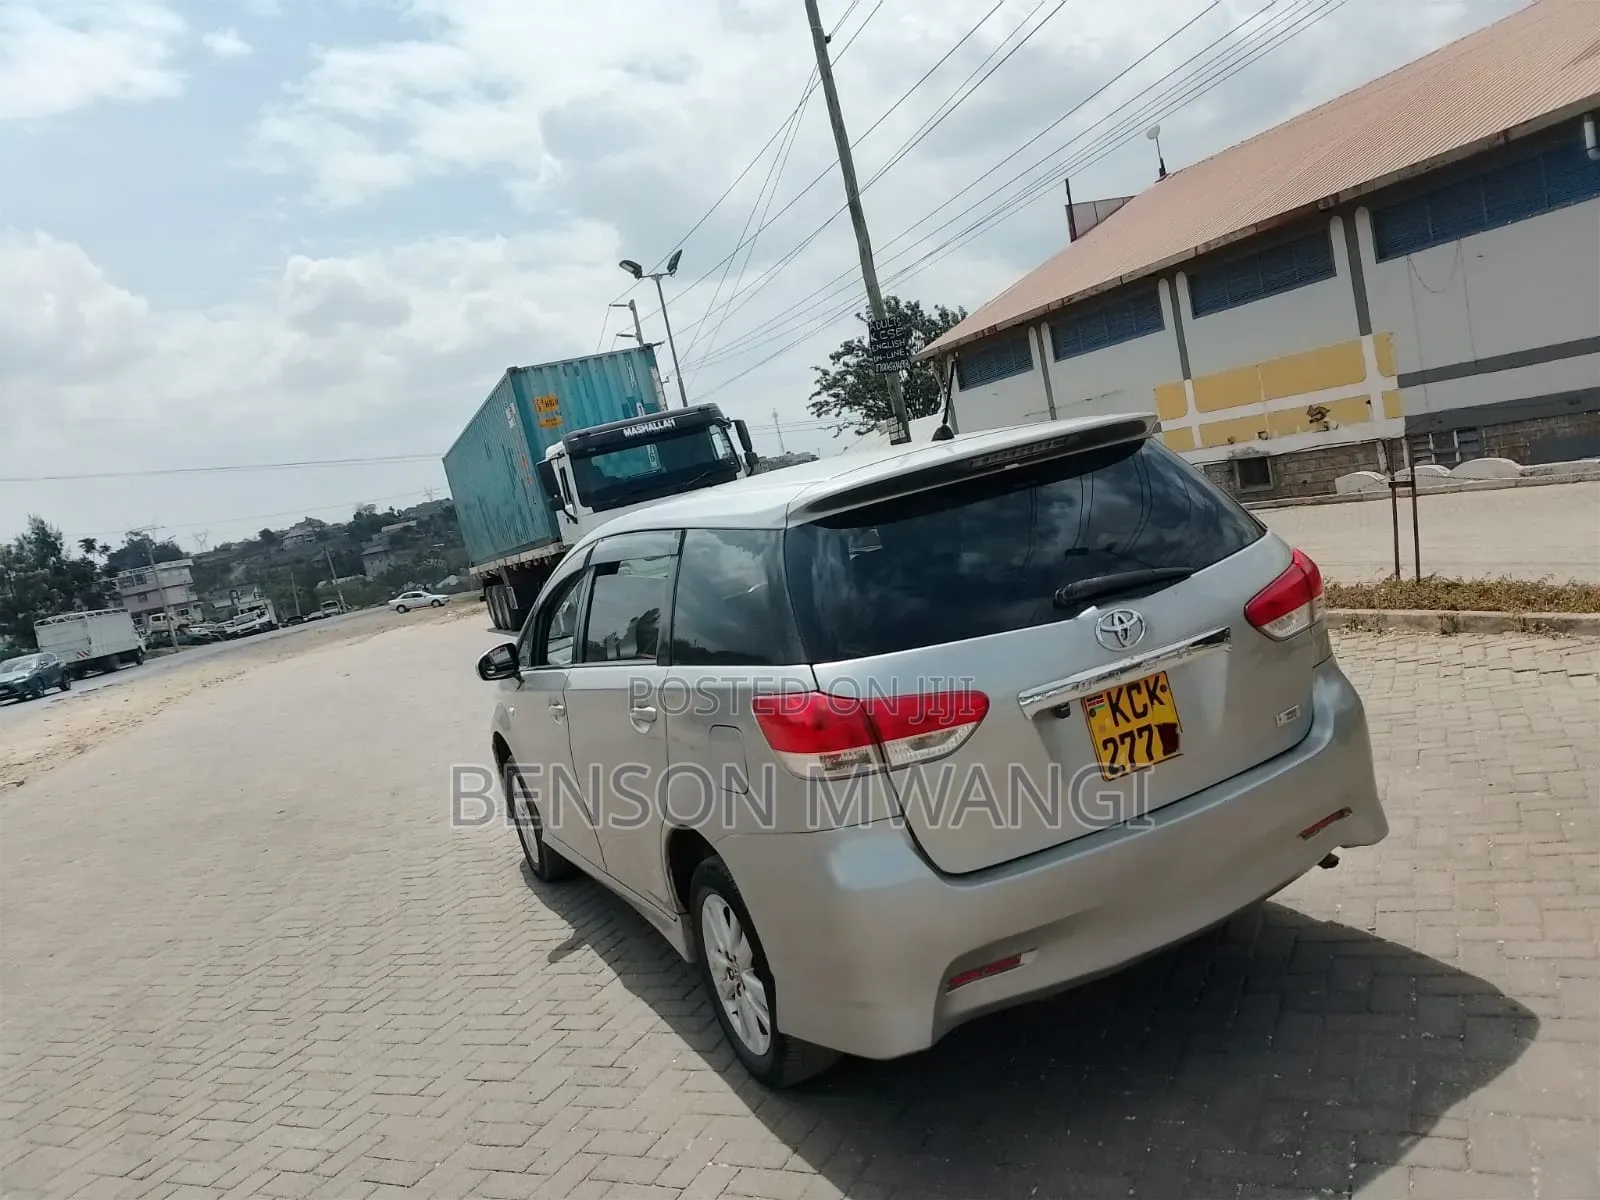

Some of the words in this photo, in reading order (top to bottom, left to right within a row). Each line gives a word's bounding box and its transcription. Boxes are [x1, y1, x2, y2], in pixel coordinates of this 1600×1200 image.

[871, 338, 905, 352] ENGLISH
[623, 418, 676, 438] MASHALLAH
[1106, 675, 1166, 728] KCK
[1102, 722, 1179, 775] 277
